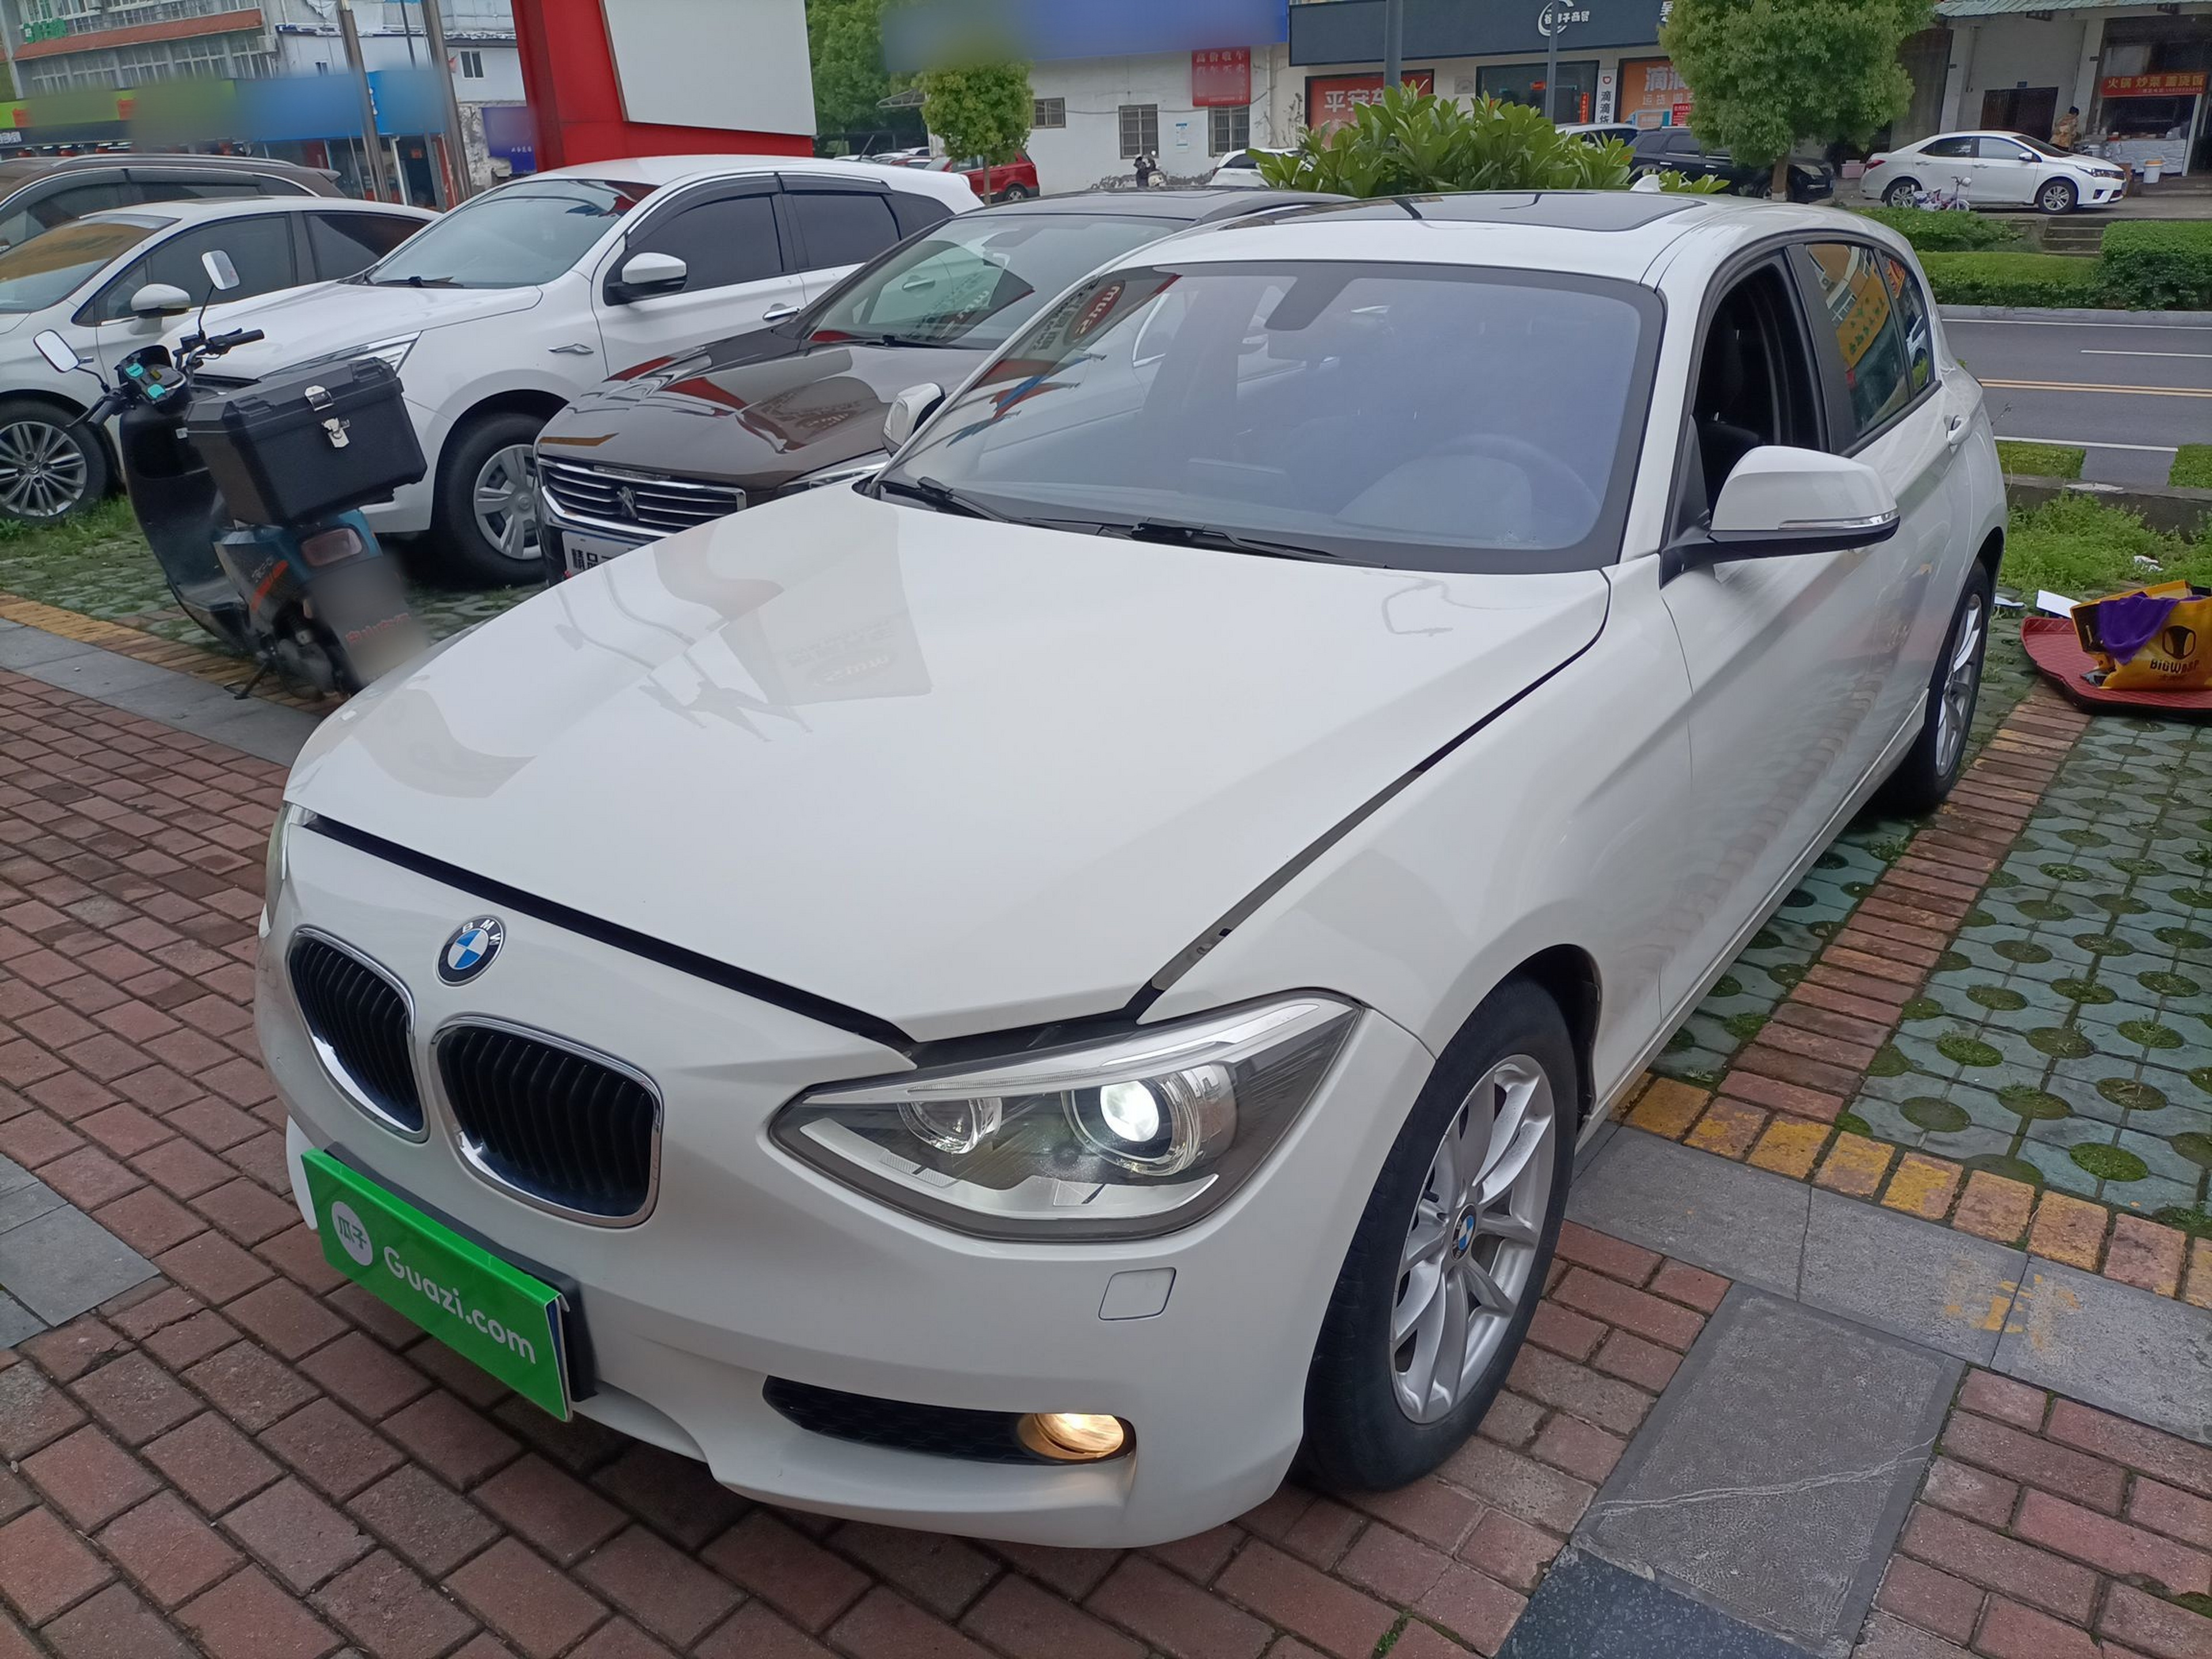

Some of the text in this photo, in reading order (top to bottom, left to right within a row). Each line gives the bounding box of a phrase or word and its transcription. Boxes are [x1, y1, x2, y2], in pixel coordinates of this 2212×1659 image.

[462, 919, 501, 945] BMW
[337, 1214, 368, 1251] 瓜子
[384, 1246, 536, 1365] Guazi.com
